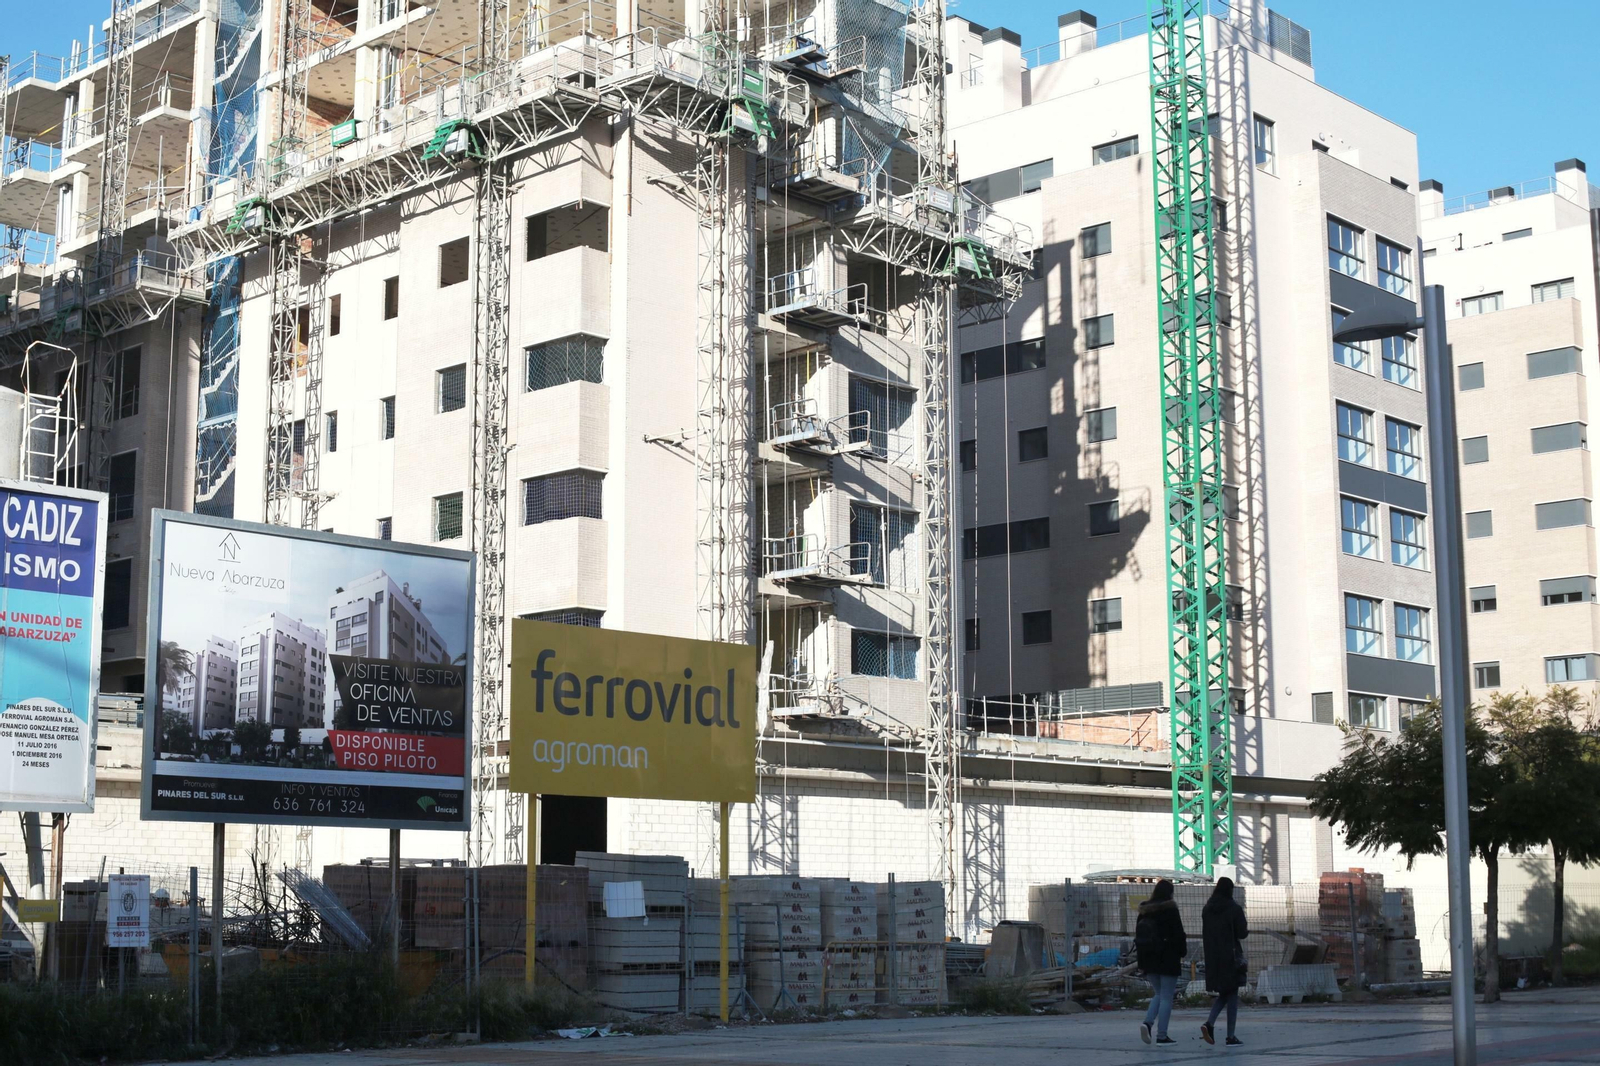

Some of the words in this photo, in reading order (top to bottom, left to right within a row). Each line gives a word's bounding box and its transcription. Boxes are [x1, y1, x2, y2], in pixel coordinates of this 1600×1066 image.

[2, 496, 83, 546] CADIZ
[169, 562, 215, 582] Nueva
[221, 569, 285, 590] Abarzuza
[11, 611, 61, 627] UNIDAD
[65, 617, 83, 629] DE
[342, 662, 391, 681] VISITE
[394, 666, 464, 686] NUESTRA
[349, 682, 416, 704] OFICINA
[530, 648, 741, 729] ferrovial
[1, 713, 33, 721] FERROVIAL
[6, 703, 31, 711] PINARES
[57, 706, 73, 714] S.L.U.
[357, 704, 381, 723] DE
[387, 706, 453, 727] VENTAS
[0, 730, 13, 738] OSÉ
[14, 731, 38, 739] MANUEL
[336, 733, 425, 753] DISPONIBLE
[343, 751, 378, 766] PISO
[384, 753, 437, 770] PILOTO
[532, 738, 649, 774] agroman
[157, 789, 192, 799] PINARES
[193, 791, 209, 800] DEL
[210, 792, 226, 801] SUR
[281, 783, 306, 795] INFO
[309, 786, 316, 795] Y
[319, 785, 361, 798] VENTAS
[273, 797, 299, 811] 636
[308, 798, 331, 813] 761
[340, 799, 365, 814] 324
[434, 805, 458, 815] Unicaja
[23, 902, 54, 913] ferrovial
